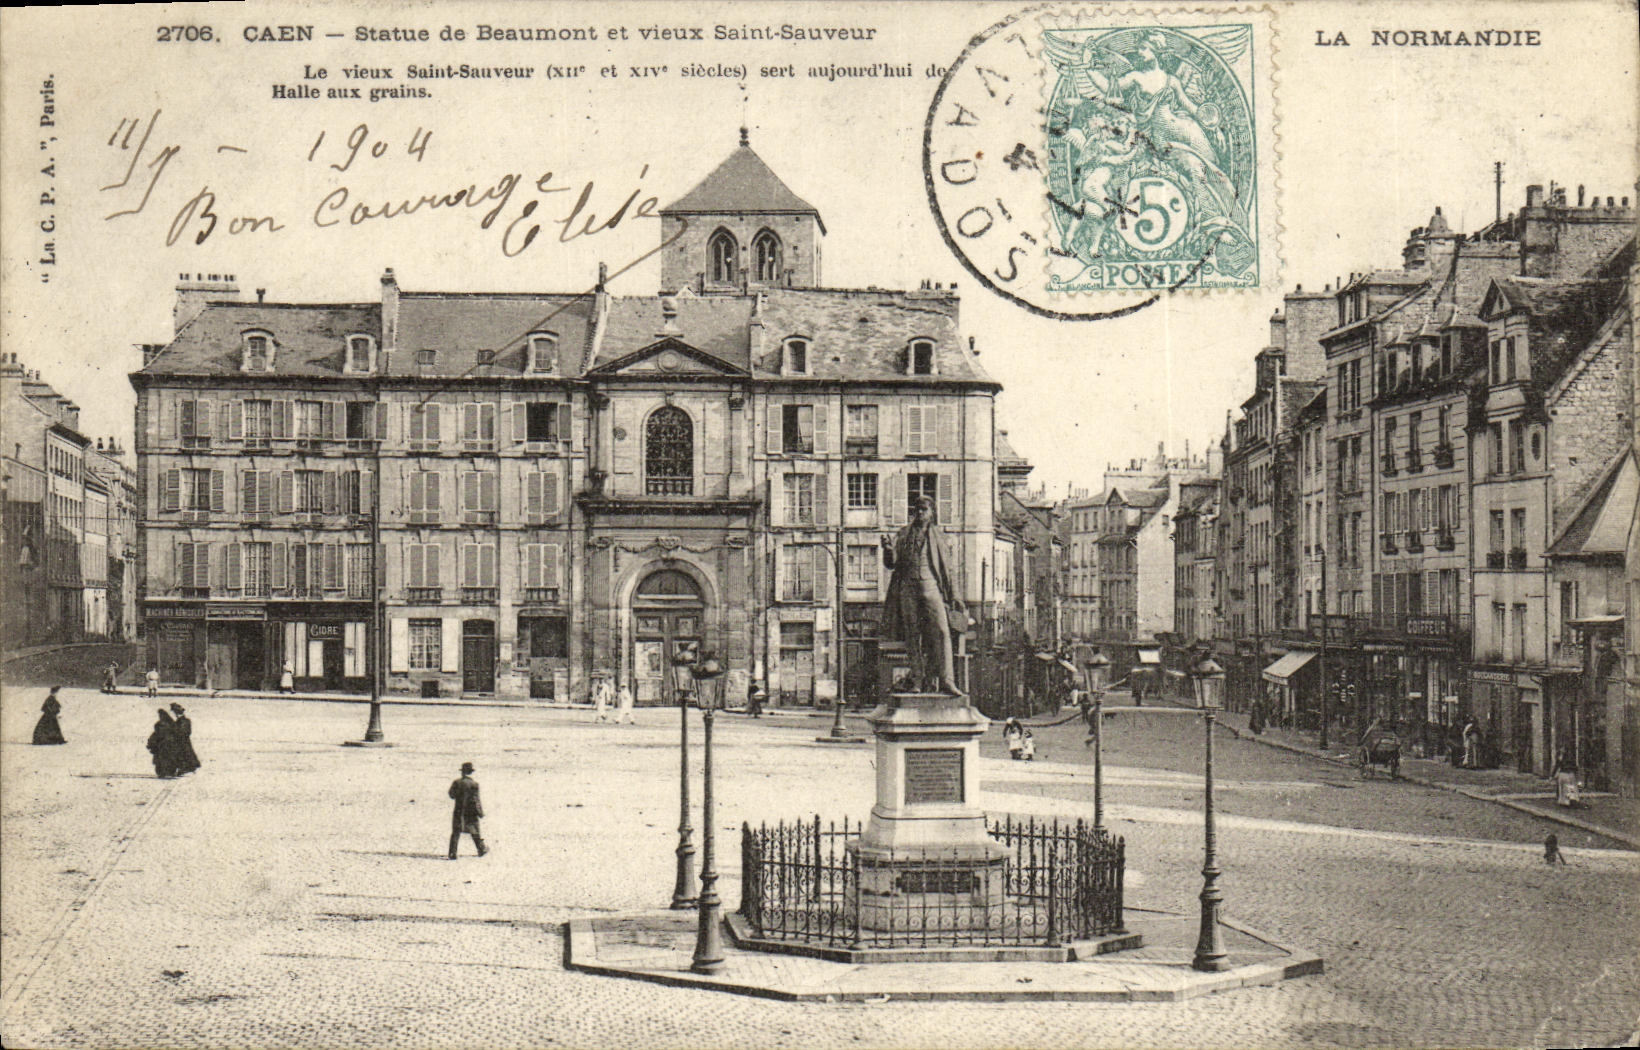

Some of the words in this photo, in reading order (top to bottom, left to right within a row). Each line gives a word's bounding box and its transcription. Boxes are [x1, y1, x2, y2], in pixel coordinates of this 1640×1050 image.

[166, 186, 284, 247] Bon
[310, 623, 339, 637] CIDRE
[1406, 619, 1447, 635] COIFFEUR
